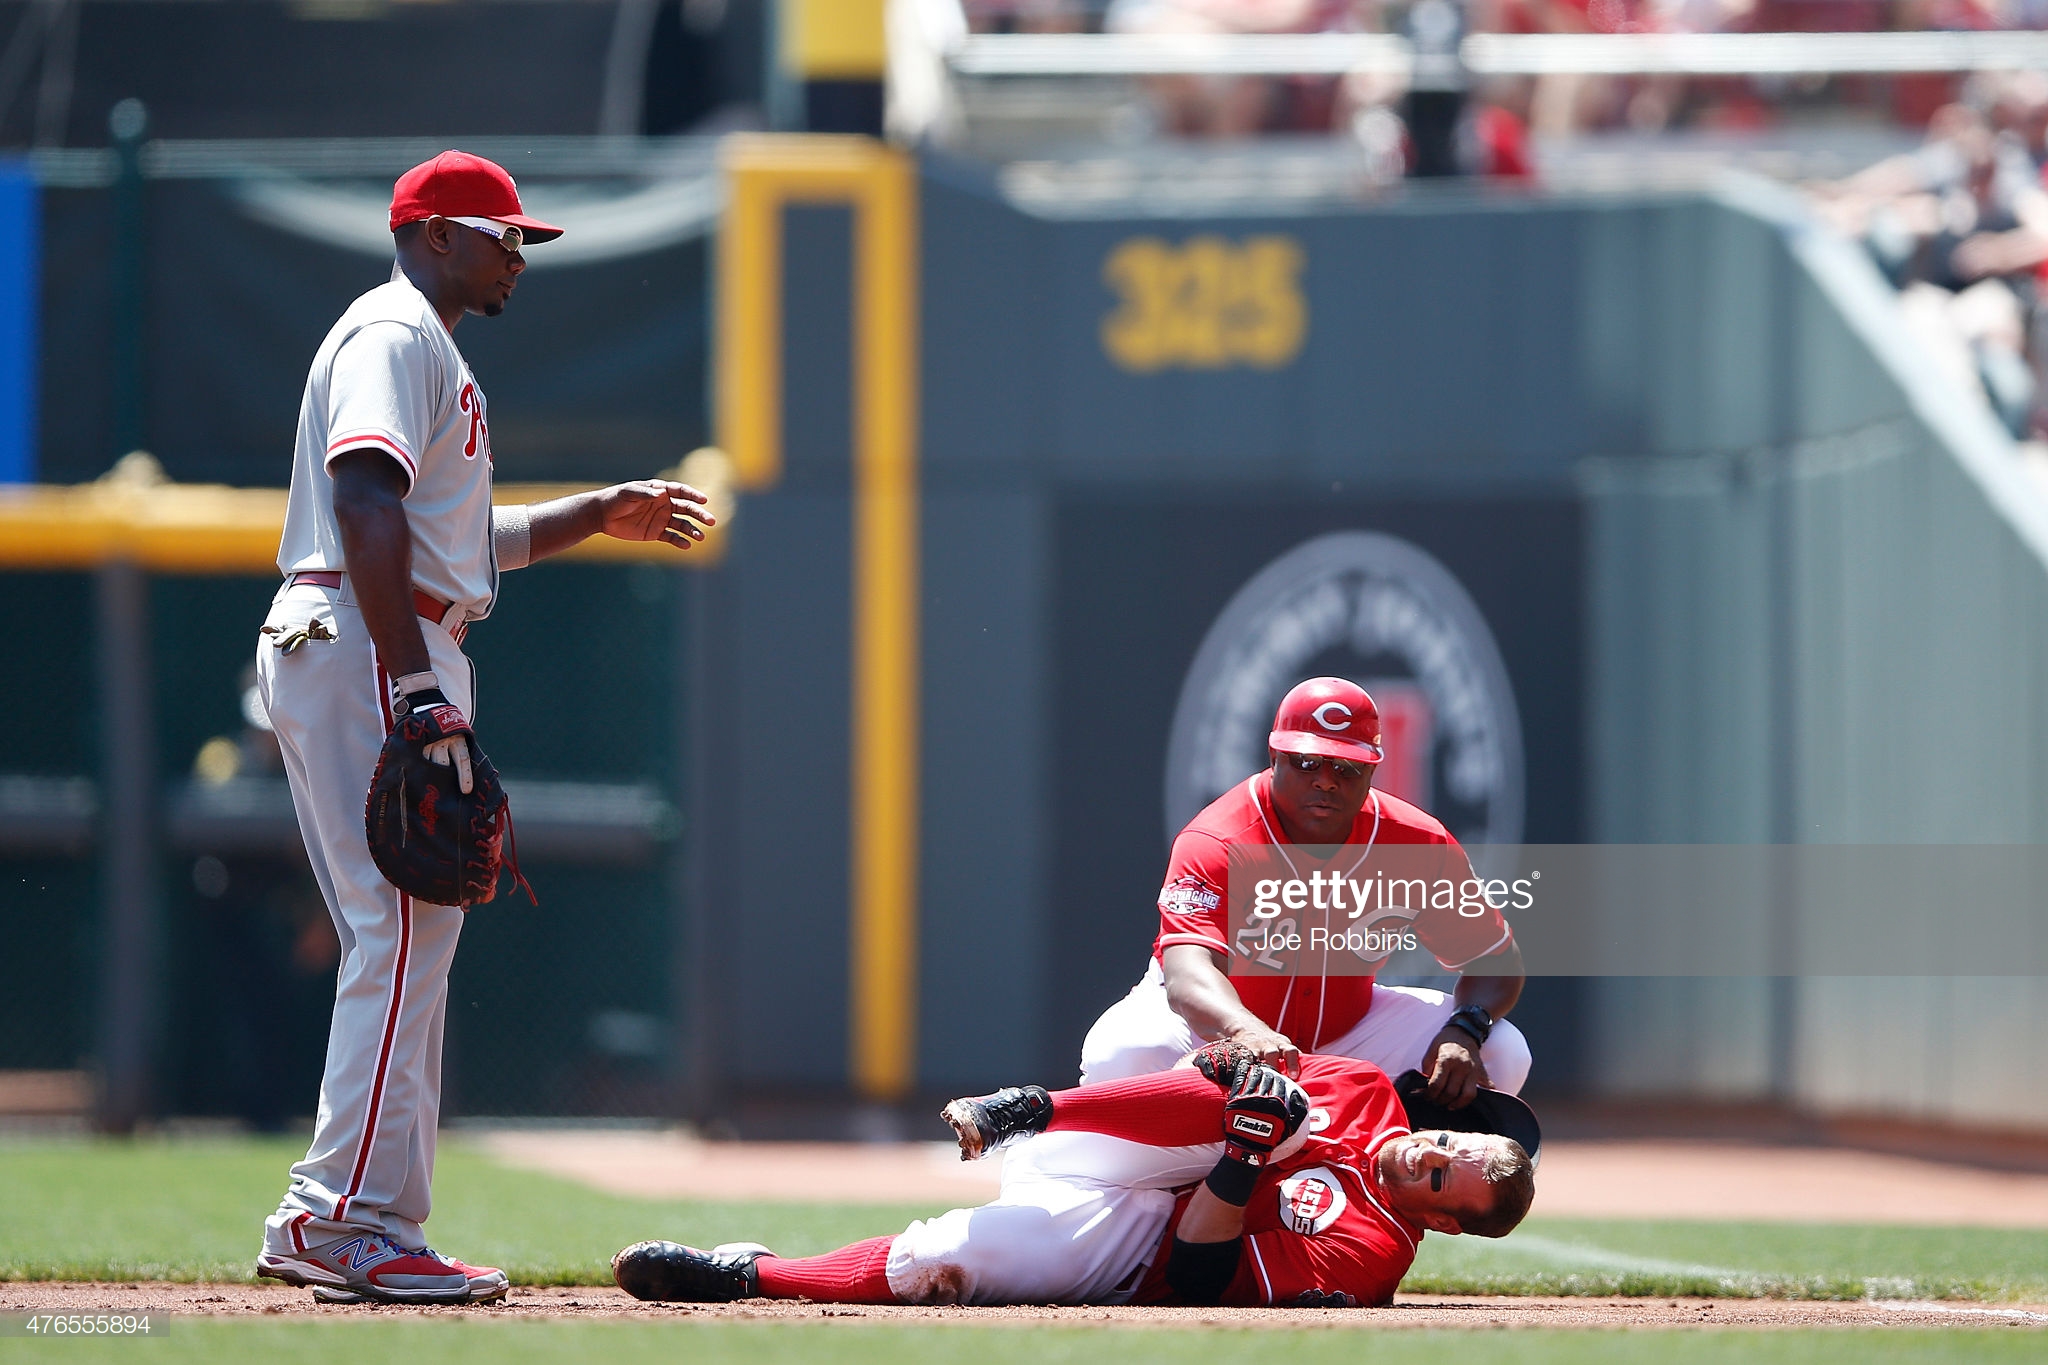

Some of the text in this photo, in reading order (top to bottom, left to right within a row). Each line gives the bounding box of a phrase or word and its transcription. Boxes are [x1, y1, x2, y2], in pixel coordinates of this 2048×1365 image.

[1102, 236, 1307, 370] 325
[1312, 702, 1352, 731] C
[1294, 1179, 1326, 1235] REDS
[329, 1236, 388, 1272] N
